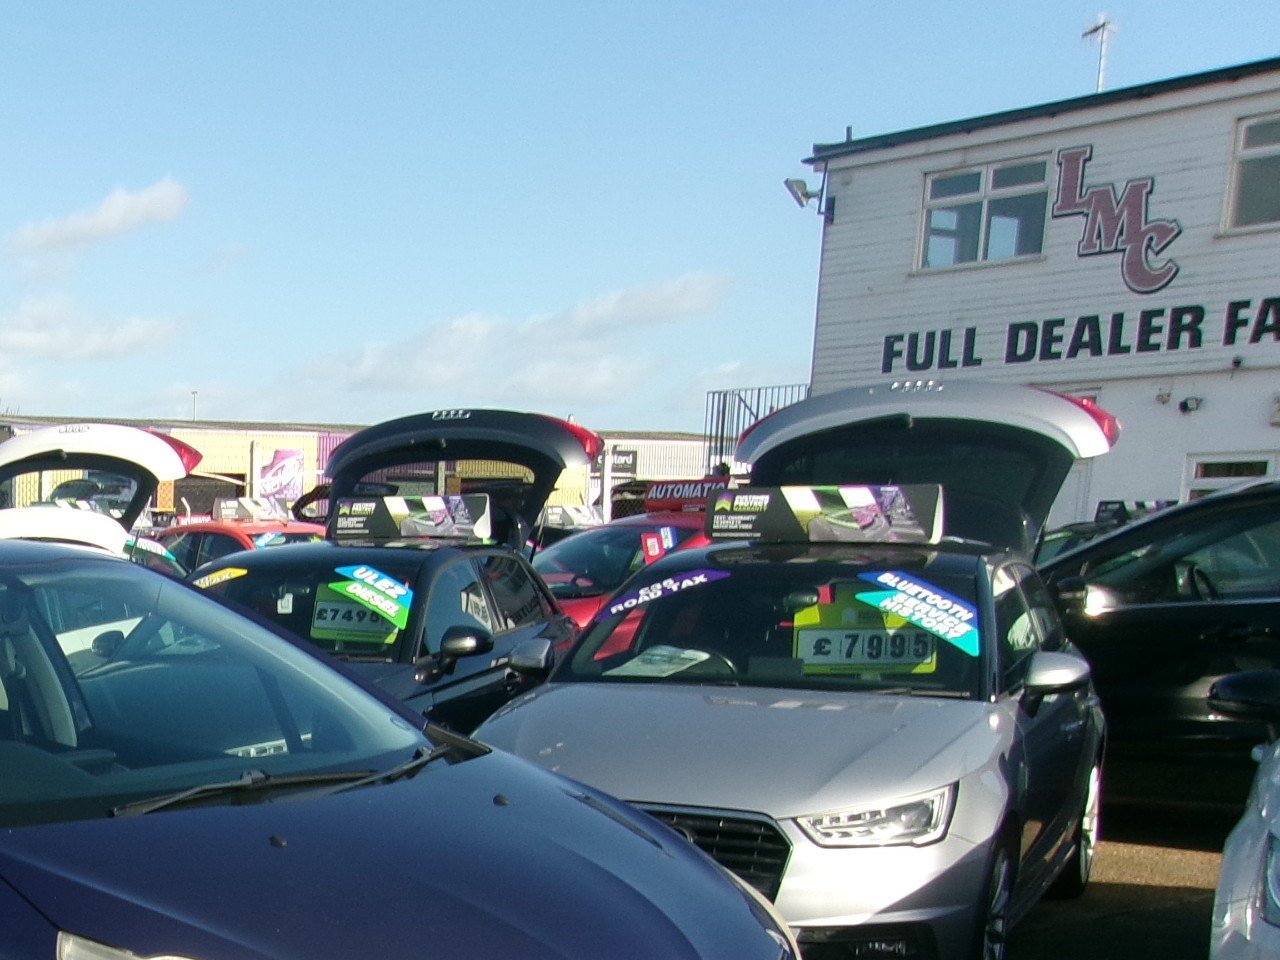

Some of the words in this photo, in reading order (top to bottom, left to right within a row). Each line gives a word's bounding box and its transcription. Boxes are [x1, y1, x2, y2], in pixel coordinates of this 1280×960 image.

[1052, 144, 1182, 294] LMC
[882, 327, 983, 374] FULL
[1004, 304, 1205, 364] DEALER
[1222, 297, 1280, 346] FA
[346, 583, 400, 618] DIESEL
[353, 567, 408, 599] ULEZ
[610, 589, 662, 614] ROAD
[671, 574, 708, 592] TAX
[877, 572, 974, 620] BLUETOOTH
[880, 598, 966, 639] HISTORY
[892, 591, 972, 633] SERVICE
[813, 633, 929, 660] £7995
